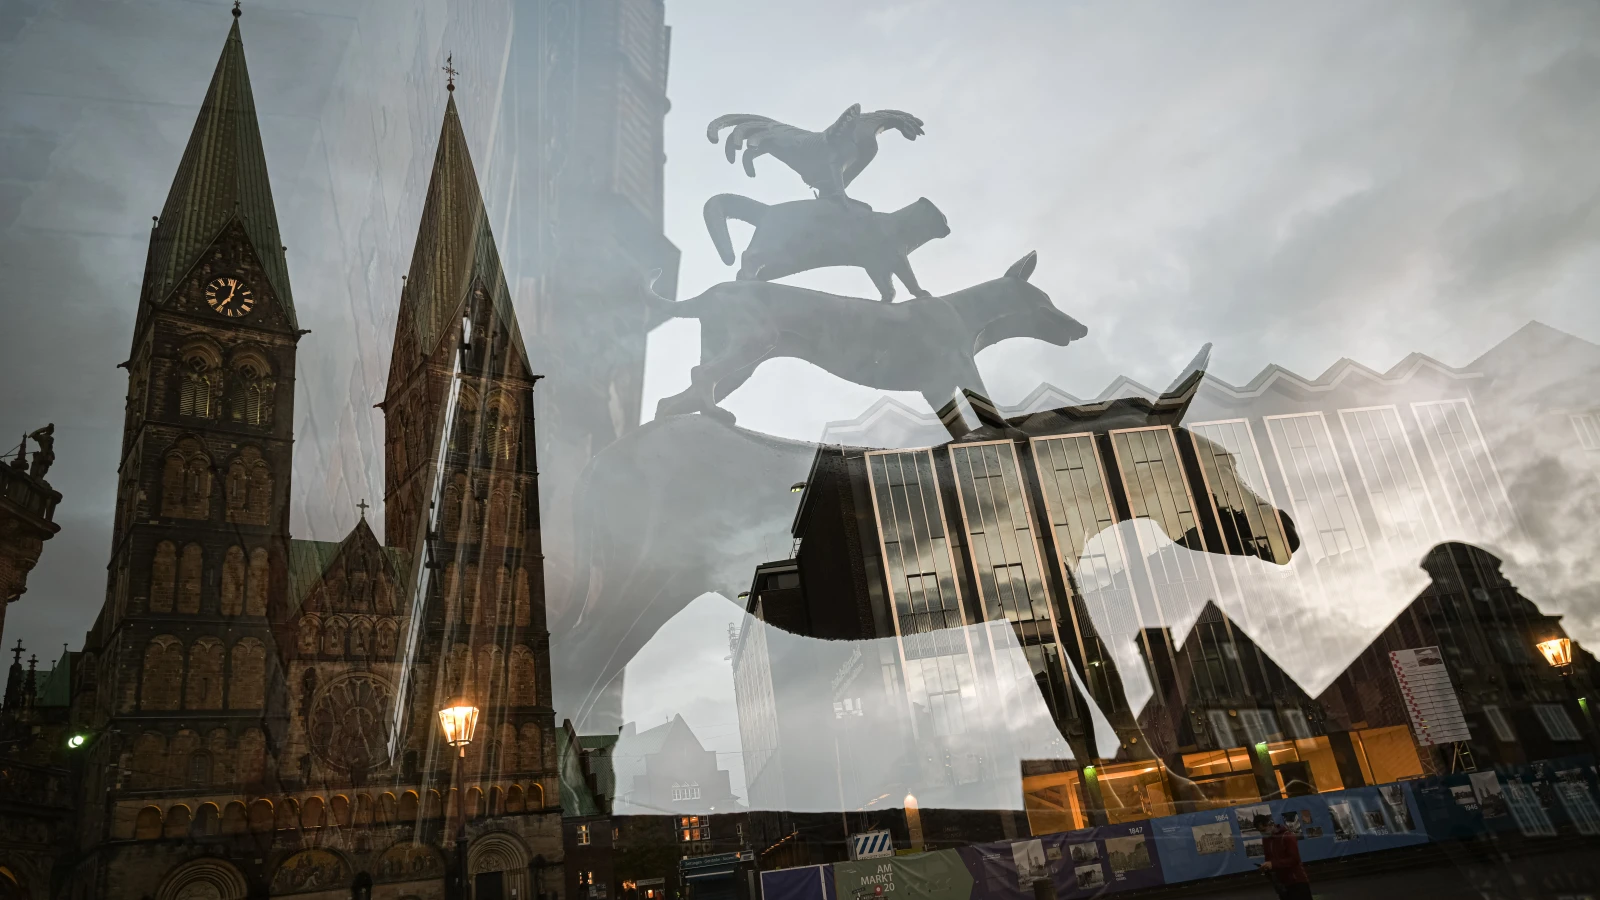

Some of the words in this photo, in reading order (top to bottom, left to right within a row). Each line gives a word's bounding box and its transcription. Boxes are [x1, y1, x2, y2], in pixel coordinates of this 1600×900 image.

[1128, 826, 1143, 835] 1847
[877, 864, 893, 874] AM
[860, 873, 893, 886] MARKT
[884, 882, 895, 892] 20
